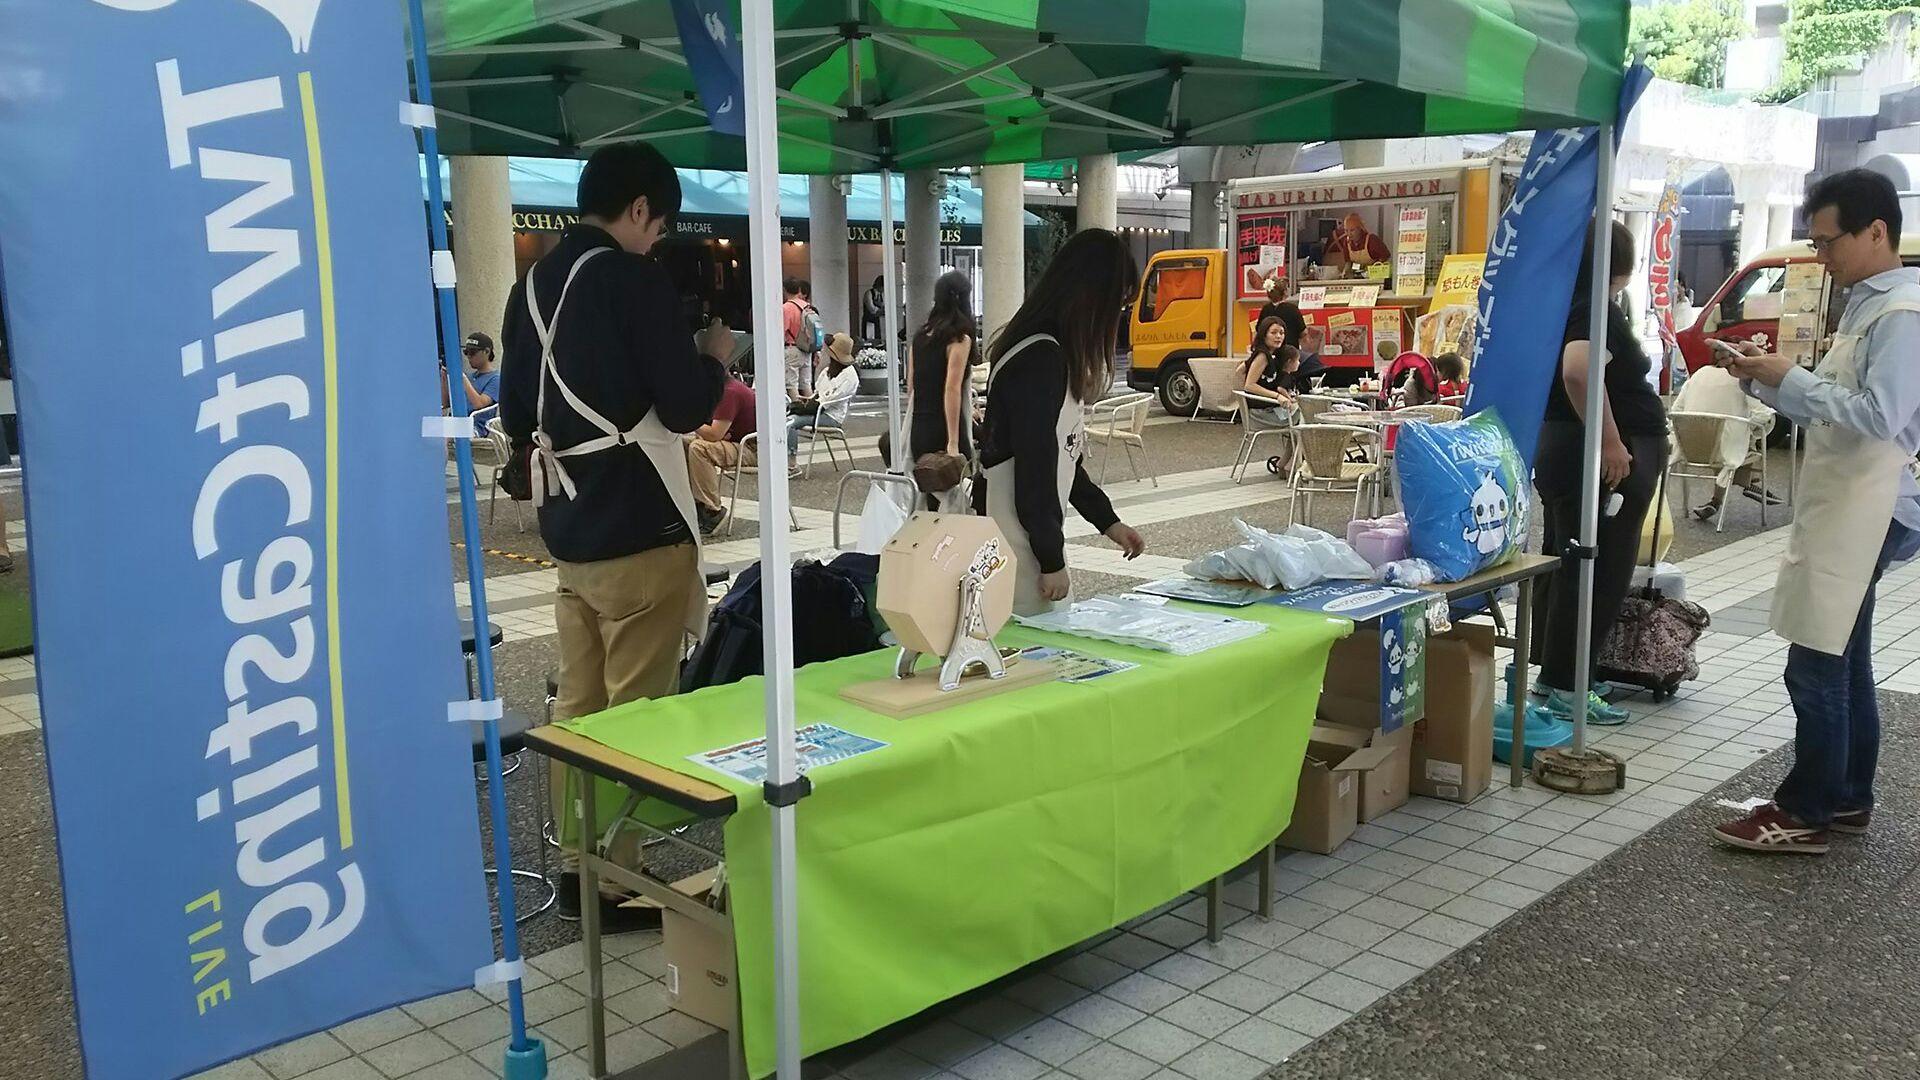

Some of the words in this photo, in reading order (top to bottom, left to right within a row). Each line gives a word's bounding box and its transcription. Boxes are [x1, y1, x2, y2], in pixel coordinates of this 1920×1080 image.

[1239, 187, 1334, 208] MARURIN
[1347, 179, 1441, 200] MONMON
[1240, 226, 1286, 246] 手羽先
